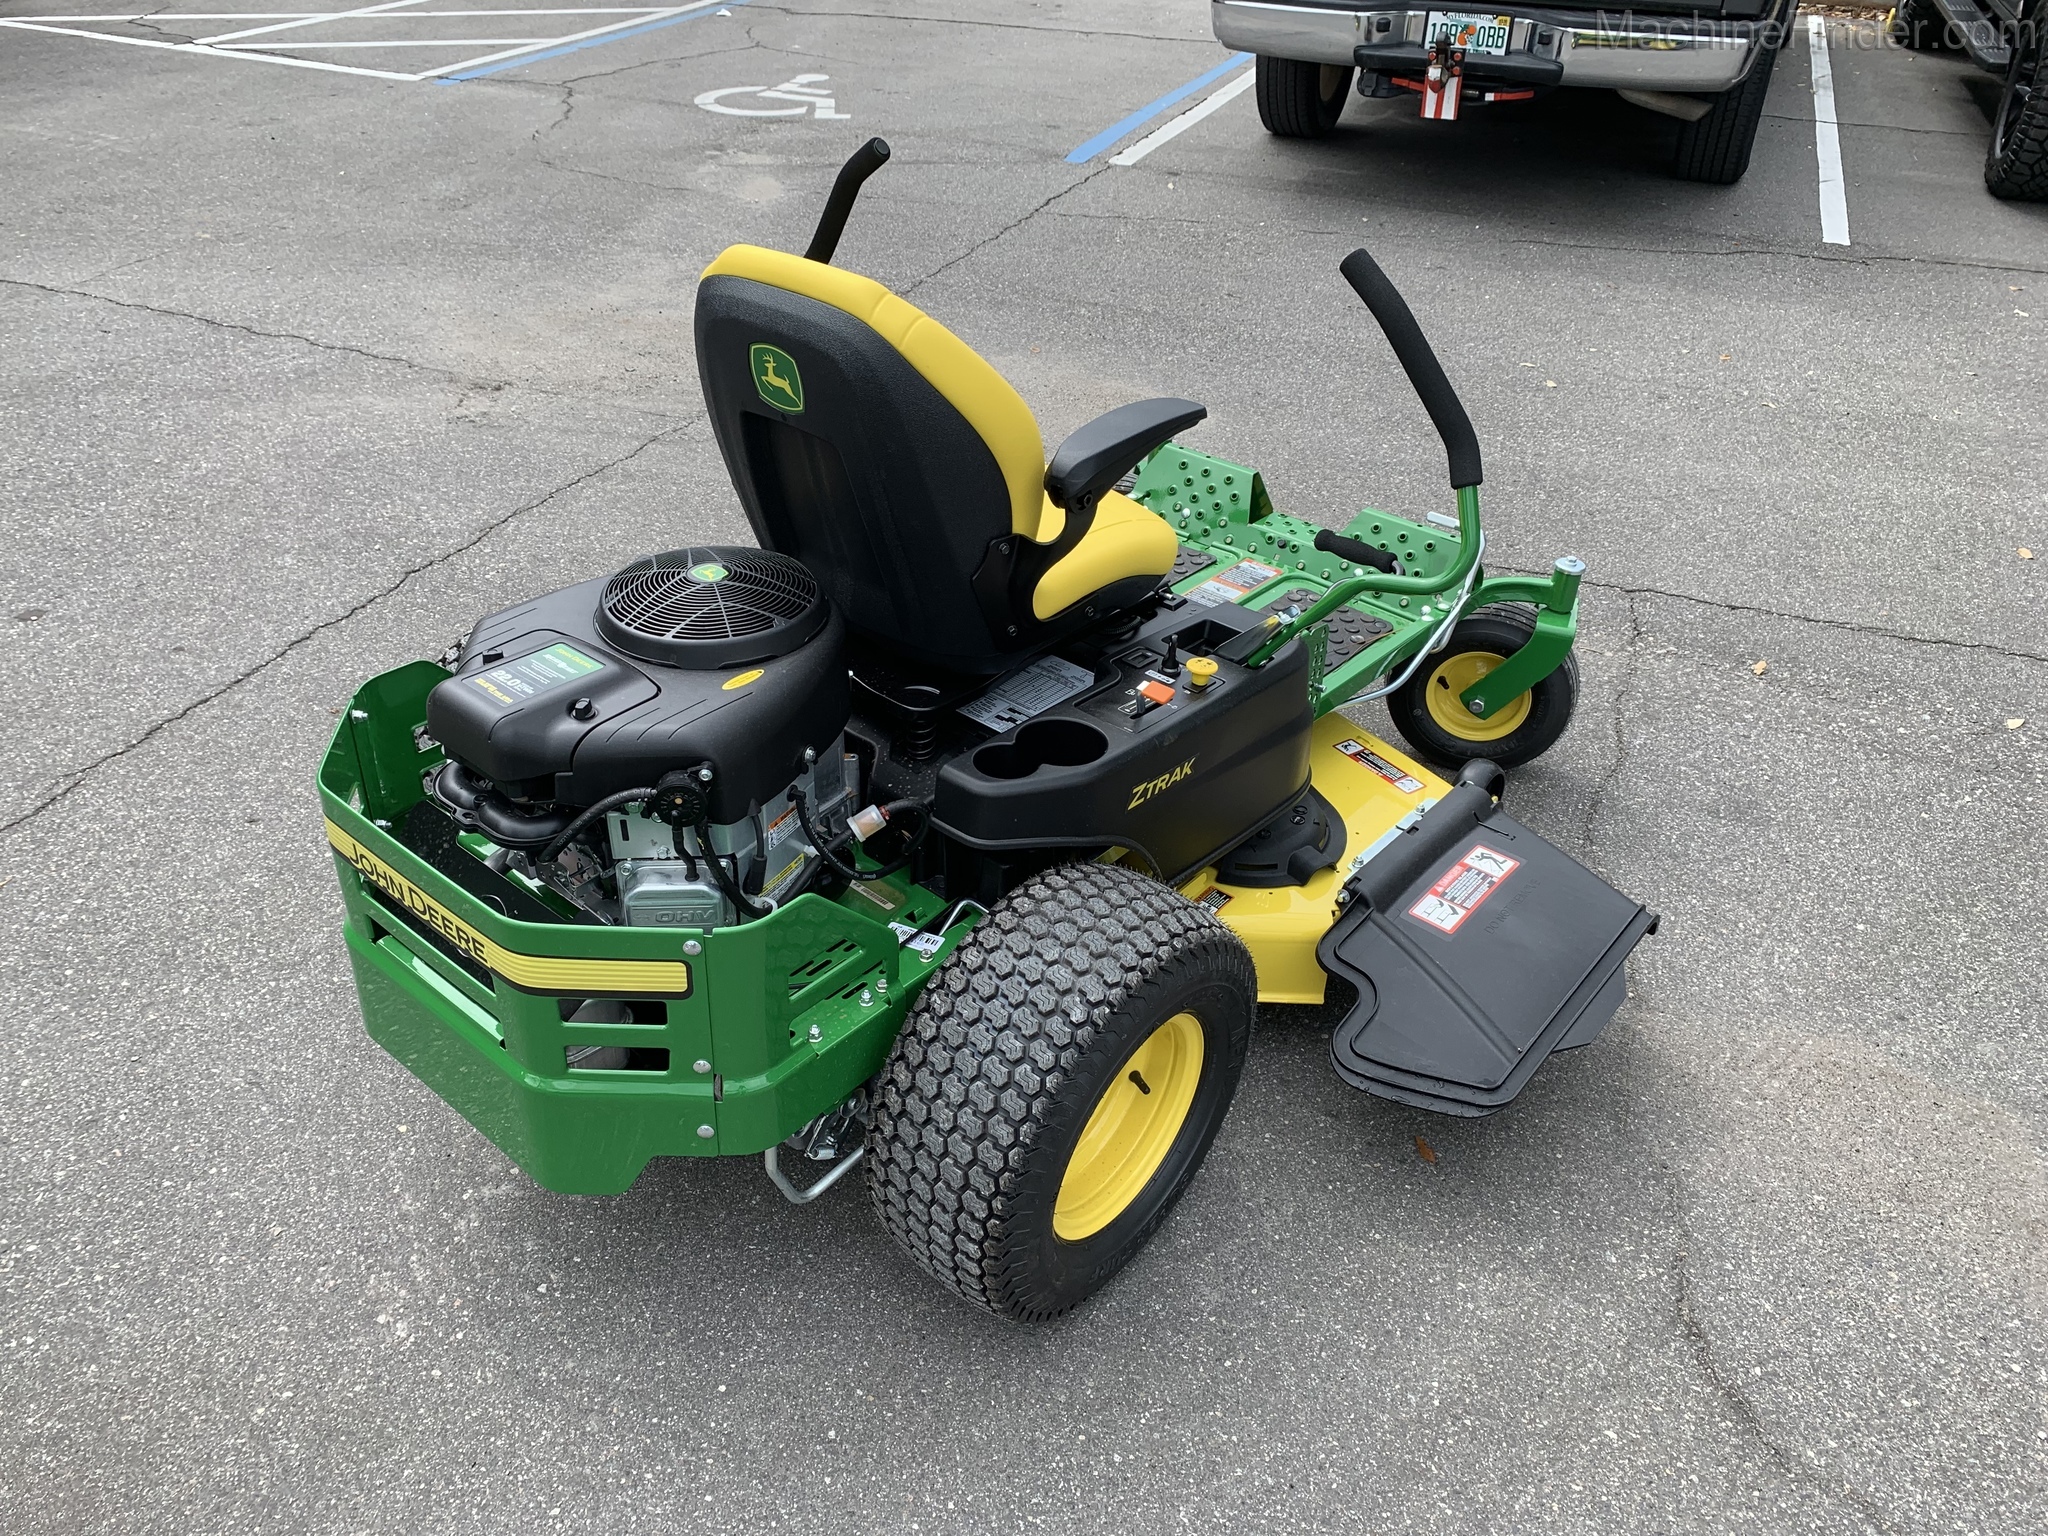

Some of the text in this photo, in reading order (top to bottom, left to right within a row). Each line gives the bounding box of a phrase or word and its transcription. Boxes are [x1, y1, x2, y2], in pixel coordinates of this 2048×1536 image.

[1127, 756, 1197, 811] ZTRAK
[349, 843, 488, 964] JOHN DEERE
[655, 910, 715, 923] OHV
